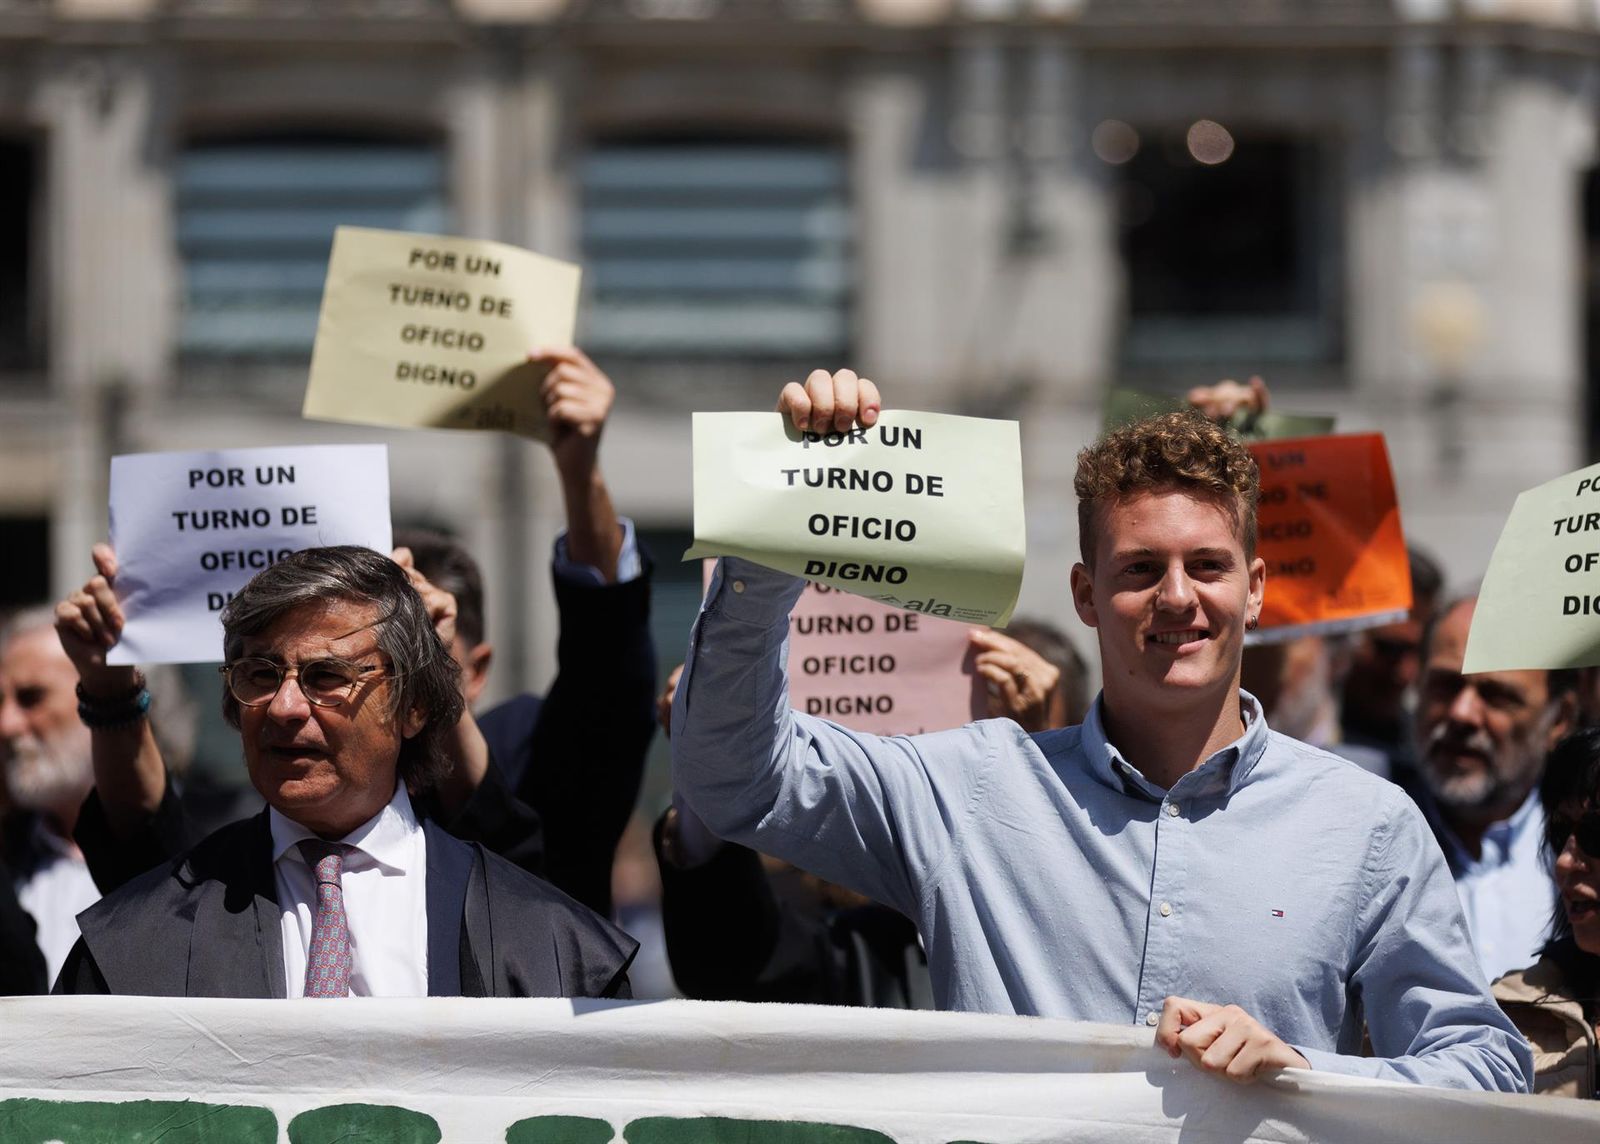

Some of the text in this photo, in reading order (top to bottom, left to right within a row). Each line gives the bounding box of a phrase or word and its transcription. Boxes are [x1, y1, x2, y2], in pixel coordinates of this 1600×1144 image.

[408, 248, 502, 276] POR UN
[388, 284, 512, 317] TURNO DE
[401, 324, 485, 351] OFICIO
[396, 362, 476, 389] DIGNO
[802, 426, 921, 449] POR UN
[189, 466, 295, 488] POR UN
[781, 468, 944, 497] TURNO DE
[172, 506, 317, 530] TURNO DE
[808, 514, 916, 542] OFICIO
[804, 560, 908, 585] DIGNO
[904, 598, 952, 616] ala
[790, 613, 919, 635] URNO DE
[803, 654, 896, 675] OFICIO
[807, 695, 894, 716] DIGNO
